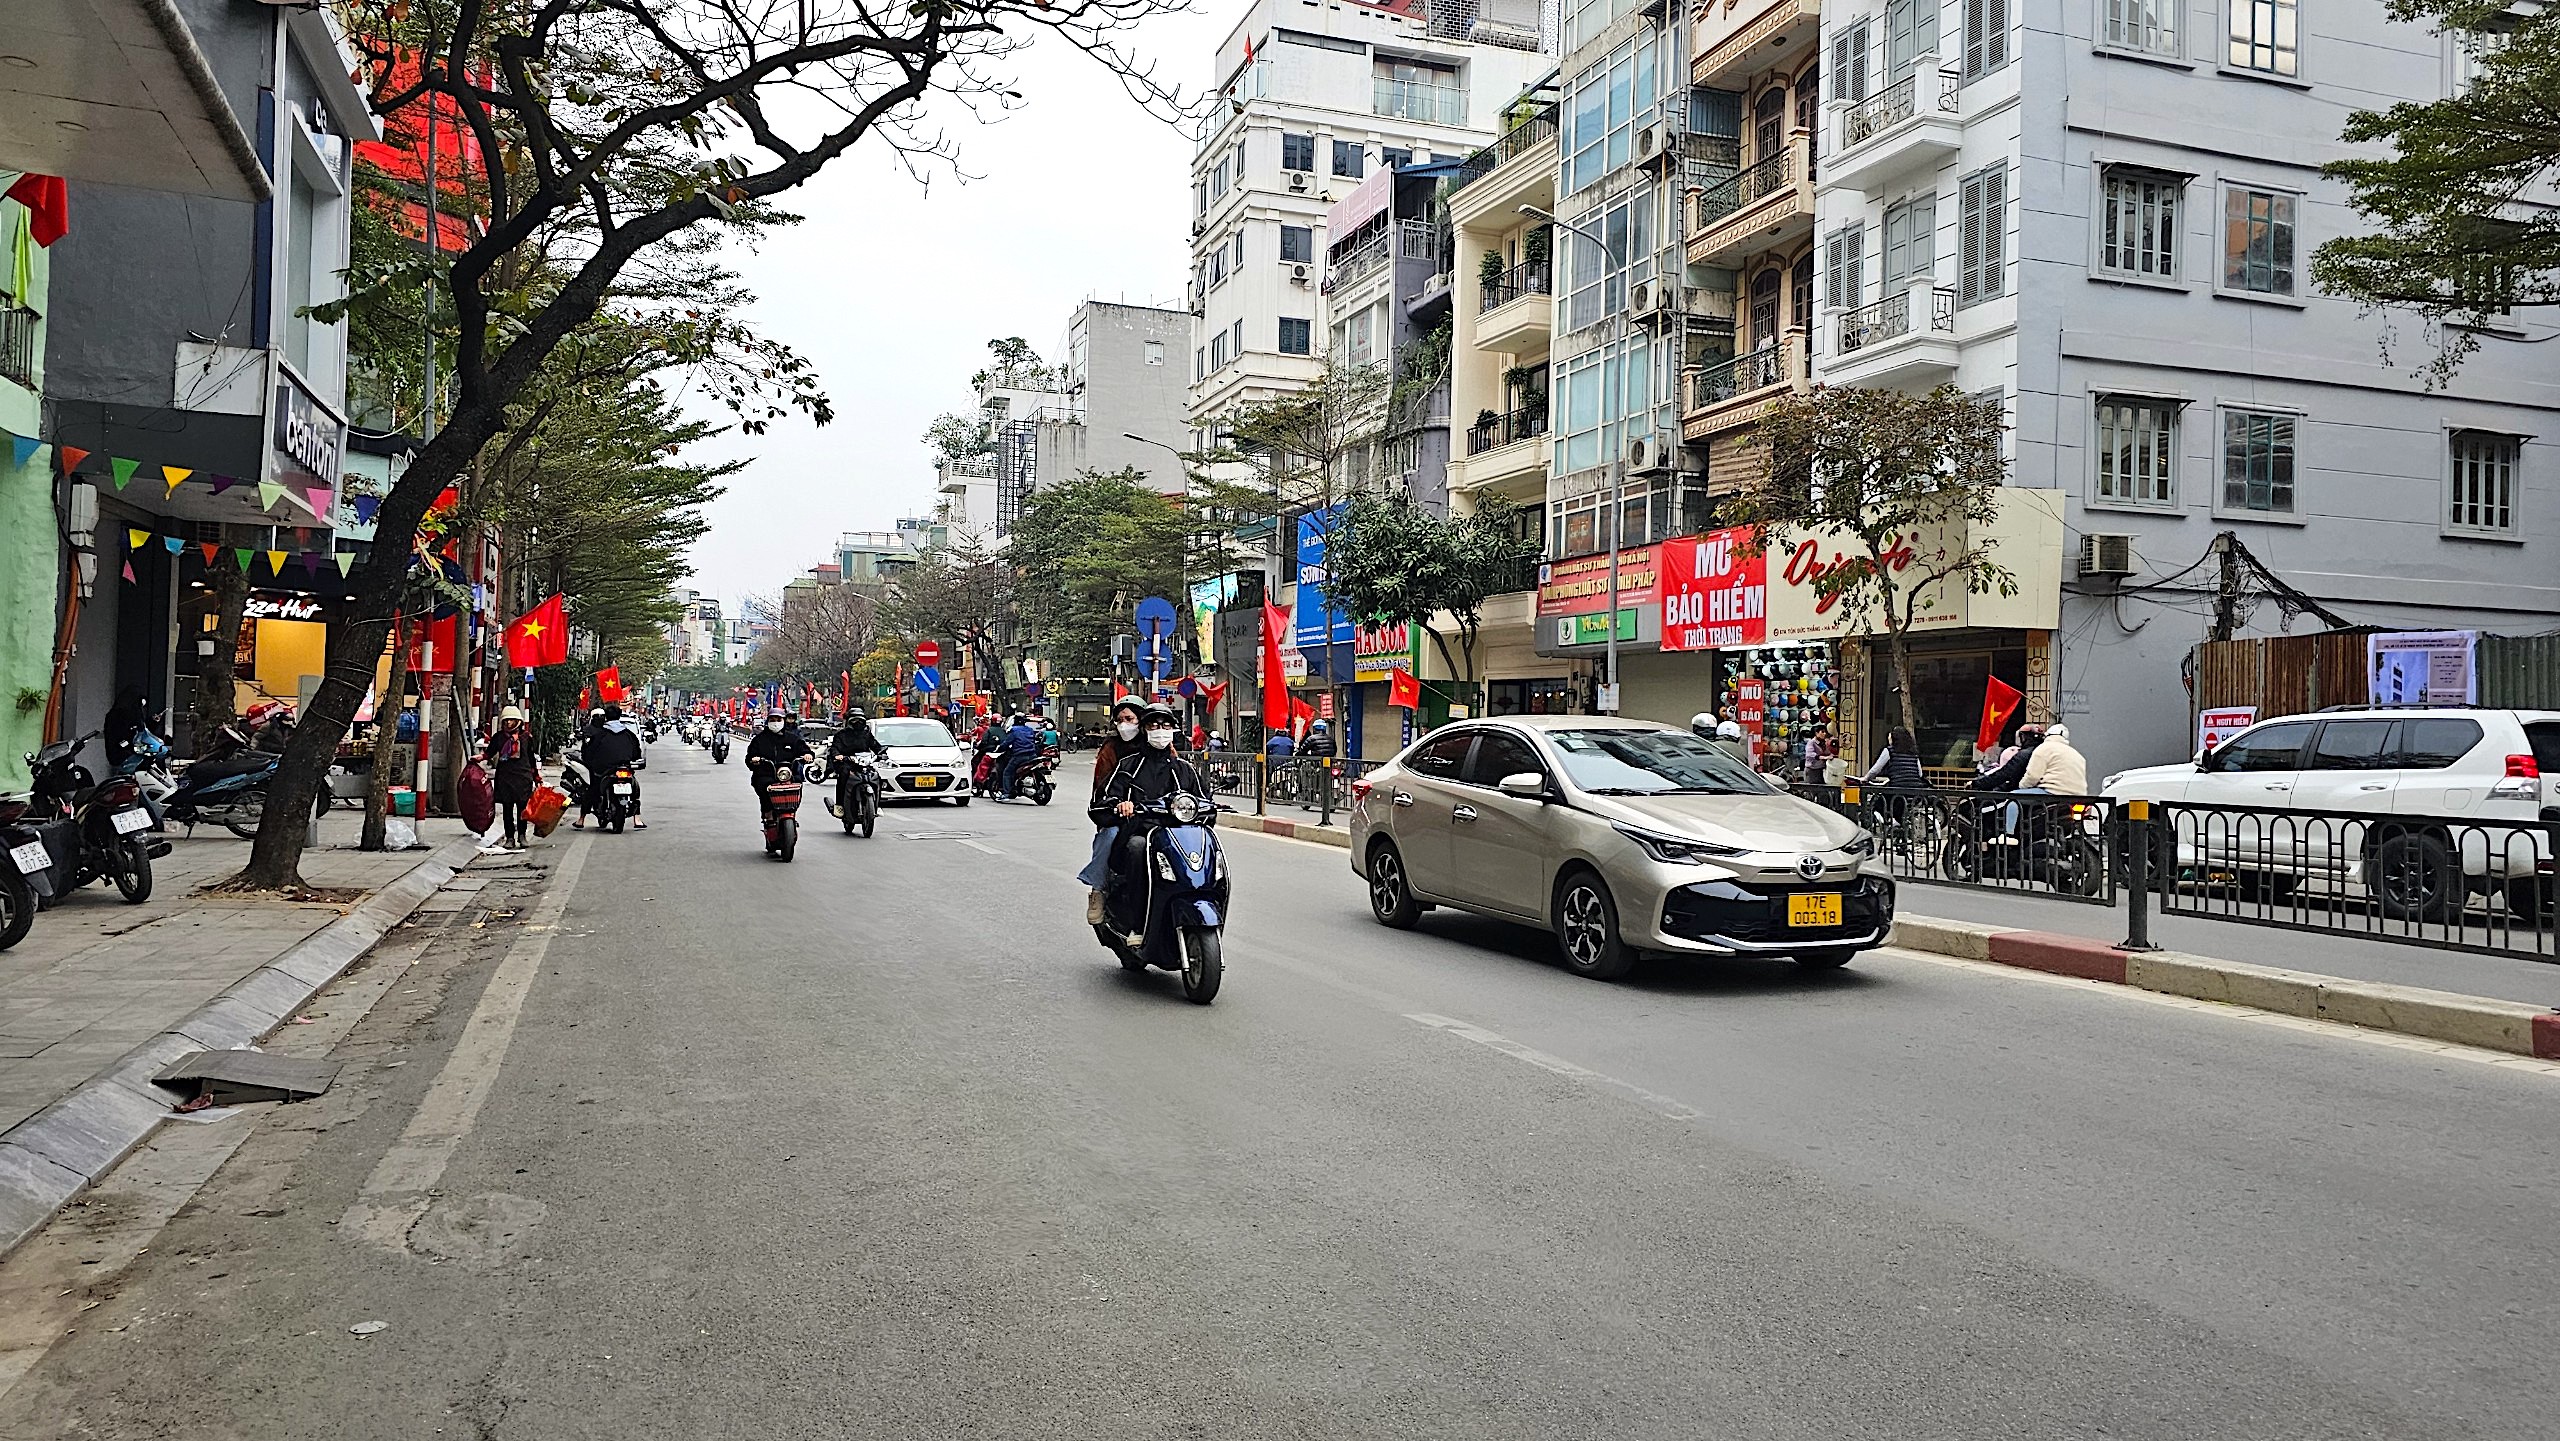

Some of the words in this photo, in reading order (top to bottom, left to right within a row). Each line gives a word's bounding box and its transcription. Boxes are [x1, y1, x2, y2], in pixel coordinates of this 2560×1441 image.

[1593, 556, 1610, 570] THÀN
[1695, 531, 1733, 579] MŨ
[1666, 582, 1703, 626] BẢO
[1709, 572, 1765, 622] HIỂM
[280, 598, 323, 619] Hut
[1708, 625, 1743, 646] TRANG
[1741, 683, 1761, 700] MŨ
[1741, 708, 1761, 721] BẢO
[1806, 895, 1827, 909] 17E
[1794, 911, 1836, 925] 003.18
